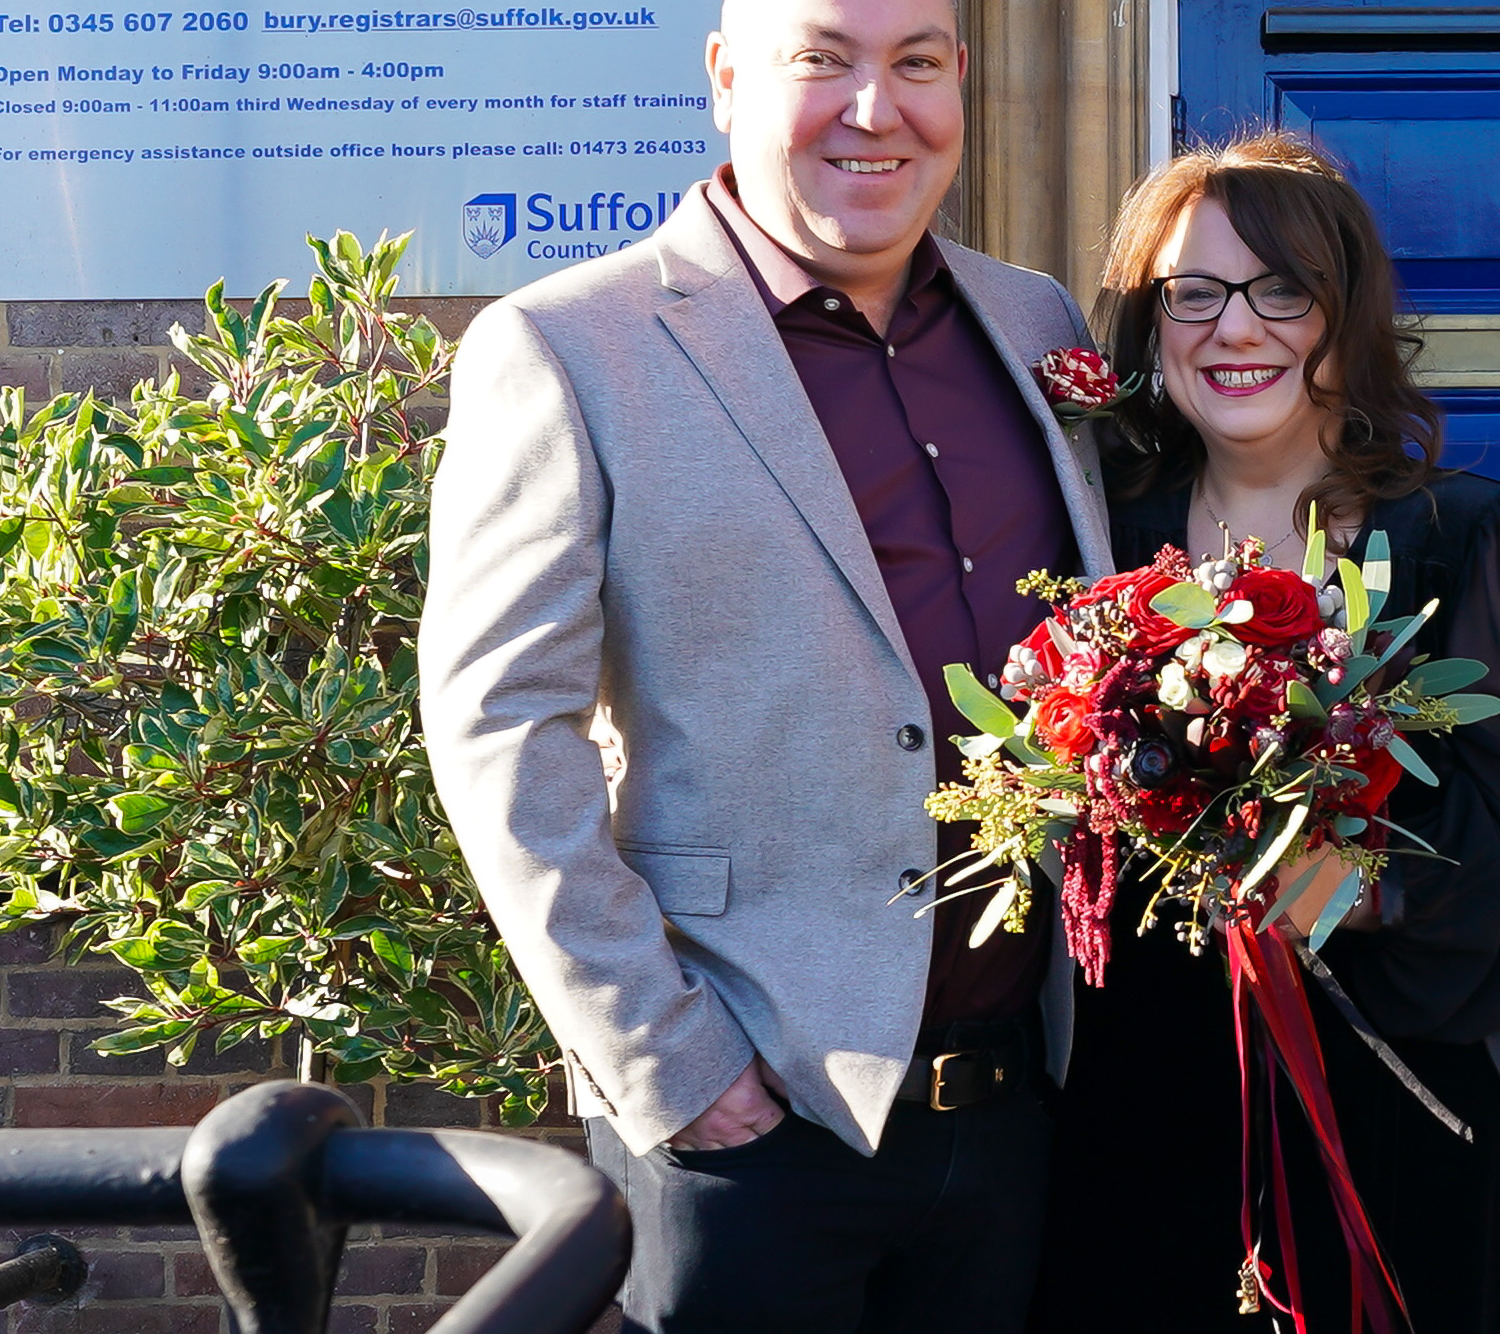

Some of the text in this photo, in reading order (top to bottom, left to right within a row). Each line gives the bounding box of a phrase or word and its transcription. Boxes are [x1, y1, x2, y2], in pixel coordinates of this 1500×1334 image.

[48, 13, 115, 33] 0345
[124, 12, 173, 32] 607
[181, 11, 251, 32] 2060
[263, 6, 658, 33] bury.registrars@suffolk.gov.uk
[58, 65, 145, 84] Monday
[152, 64, 174, 80] to
[182, 63, 251, 84] Friday
[258, 62, 340, 80] 9:00am
[361, 61, 445, 82] 4:00pm
[63, 99, 131, 113] 9:00am
[150, 97, 230, 113] 11:00am
[236, 97, 281, 112] third
[287, 96, 395, 114] Wednesday
[401, 96, 420, 110] of
[426, 97, 479, 113] every
[485, 95, 545, 109] month
[550, 94, 577, 108] for
[582, 93, 628, 108] staff
[634, 93, 707, 110] training
[28, 149, 135, 164] emergency
[141, 145, 246, 160] assistance
[252, 143, 324, 158] outside
[330, 142, 386, 157] office
[392, 142, 446, 157] hours
[452, 142, 516, 159] please
[522, 140, 564, 156] call:
[570, 140, 628, 156] 01473
[634, 139, 707, 155] 264033
[526, 239, 609, 259] County
